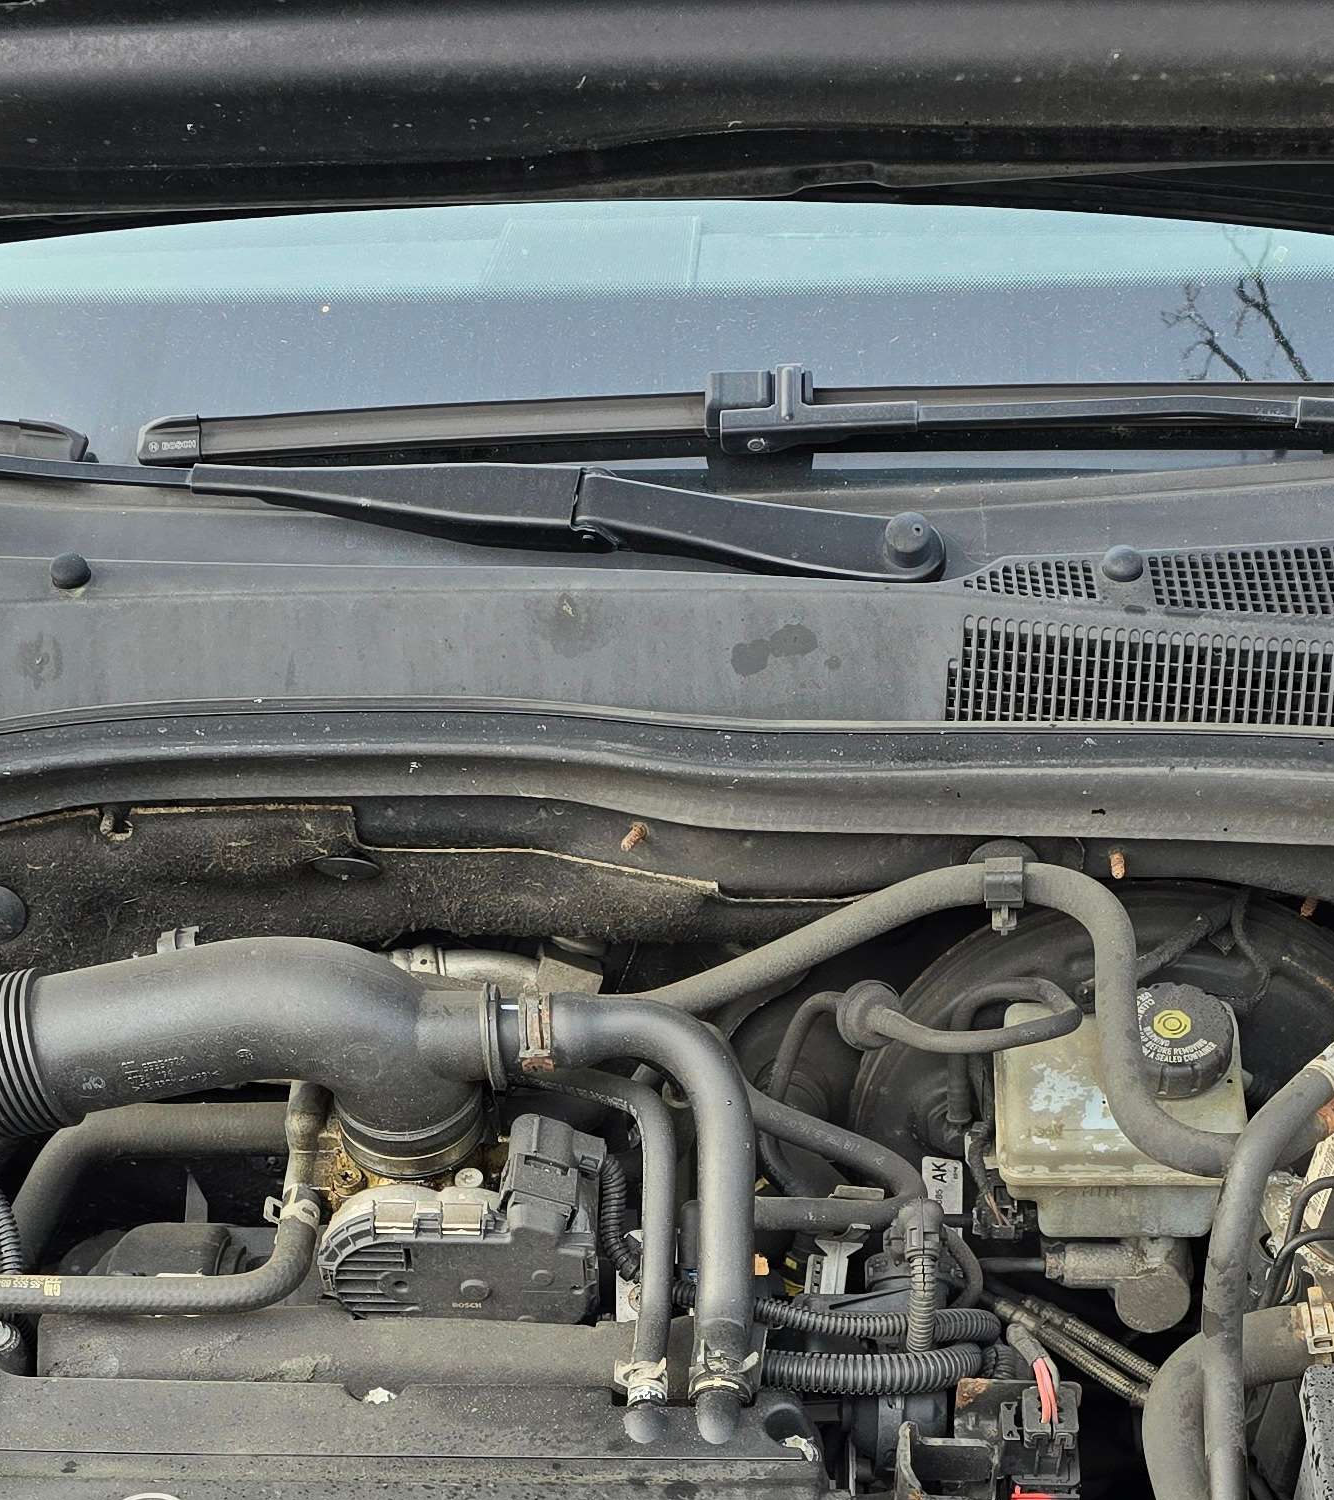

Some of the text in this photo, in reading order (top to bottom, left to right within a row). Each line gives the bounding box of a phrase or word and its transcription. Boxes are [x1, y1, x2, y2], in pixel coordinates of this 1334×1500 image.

[162, 440, 196, 450] BOSCH
[1143, 1027, 1170, 1046] WARNING
[1145, 1041, 1172, 1055] BEFORE
[1173, 1038, 1207, 1055] REMOVING
[1155, 1053, 1182, 1063] SEALED
[1183, 1041, 1217, 1062] CONTAINER
[931, 1162, 947, 1182] AK
